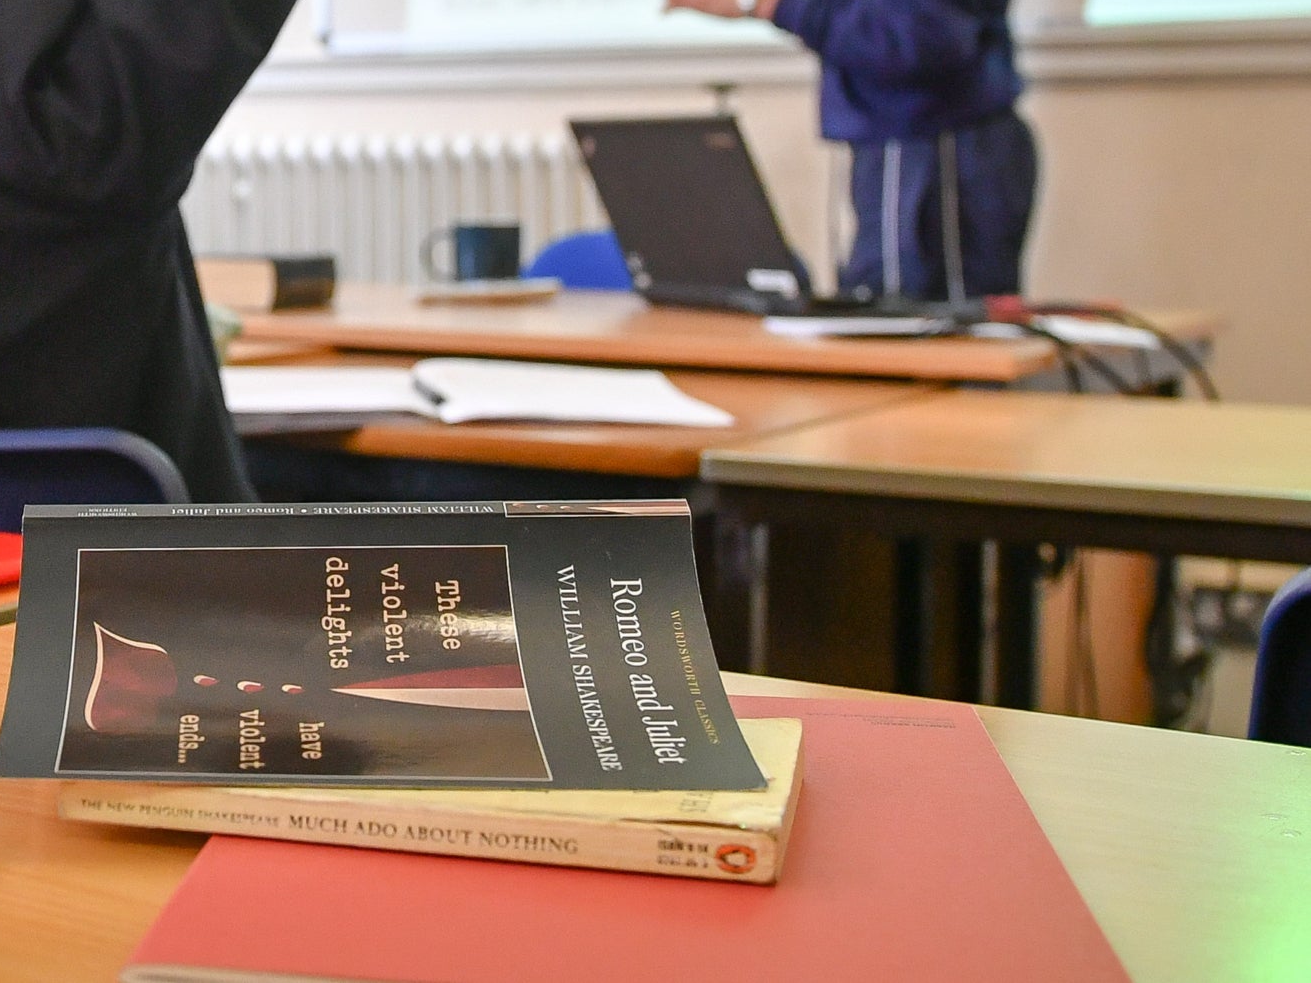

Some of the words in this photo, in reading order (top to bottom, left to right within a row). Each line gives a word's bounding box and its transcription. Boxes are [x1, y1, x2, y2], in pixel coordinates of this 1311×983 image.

[172, 506, 211, 516] Juliet
[216, 507, 241, 516] and
[246, 507, 294, 516] Romeo
[314, 506, 421, 515] SHAKESPEARE
[427, 505, 494, 515] WILLIAM
[322, 556, 350, 669] delights
[380, 563, 410, 664] violent
[435, 580, 461, 650] These
[557, 565, 588, 659] WILLIAM
[610, 578, 648, 667] Romeo
[629, 674, 673, 712] and
[670, 610, 701, 695] WORDSWORTH
[694, 699, 720, 746] CLASSICS
[178, 714, 205, 764] ends...
[239, 708, 266, 769] violent
[299, 721, 325, 760] have
[572, 664, 622, 771] SHAKESPEARE
[642, 717, 688, 764] Juliet
[81, 798, 102, 811] THE
[107, 802, 136, 813] NEW
[139, 804, 194, 819] PENGUIN
[197, 809, 280, 828] SHAKESPEARE
[288, 815, 348, 834] MUCH
[354, 821, 398, 838] ADO
[404, 825, 474, 846] ABOUT
[478, 831, 579, 855] NOTHING
